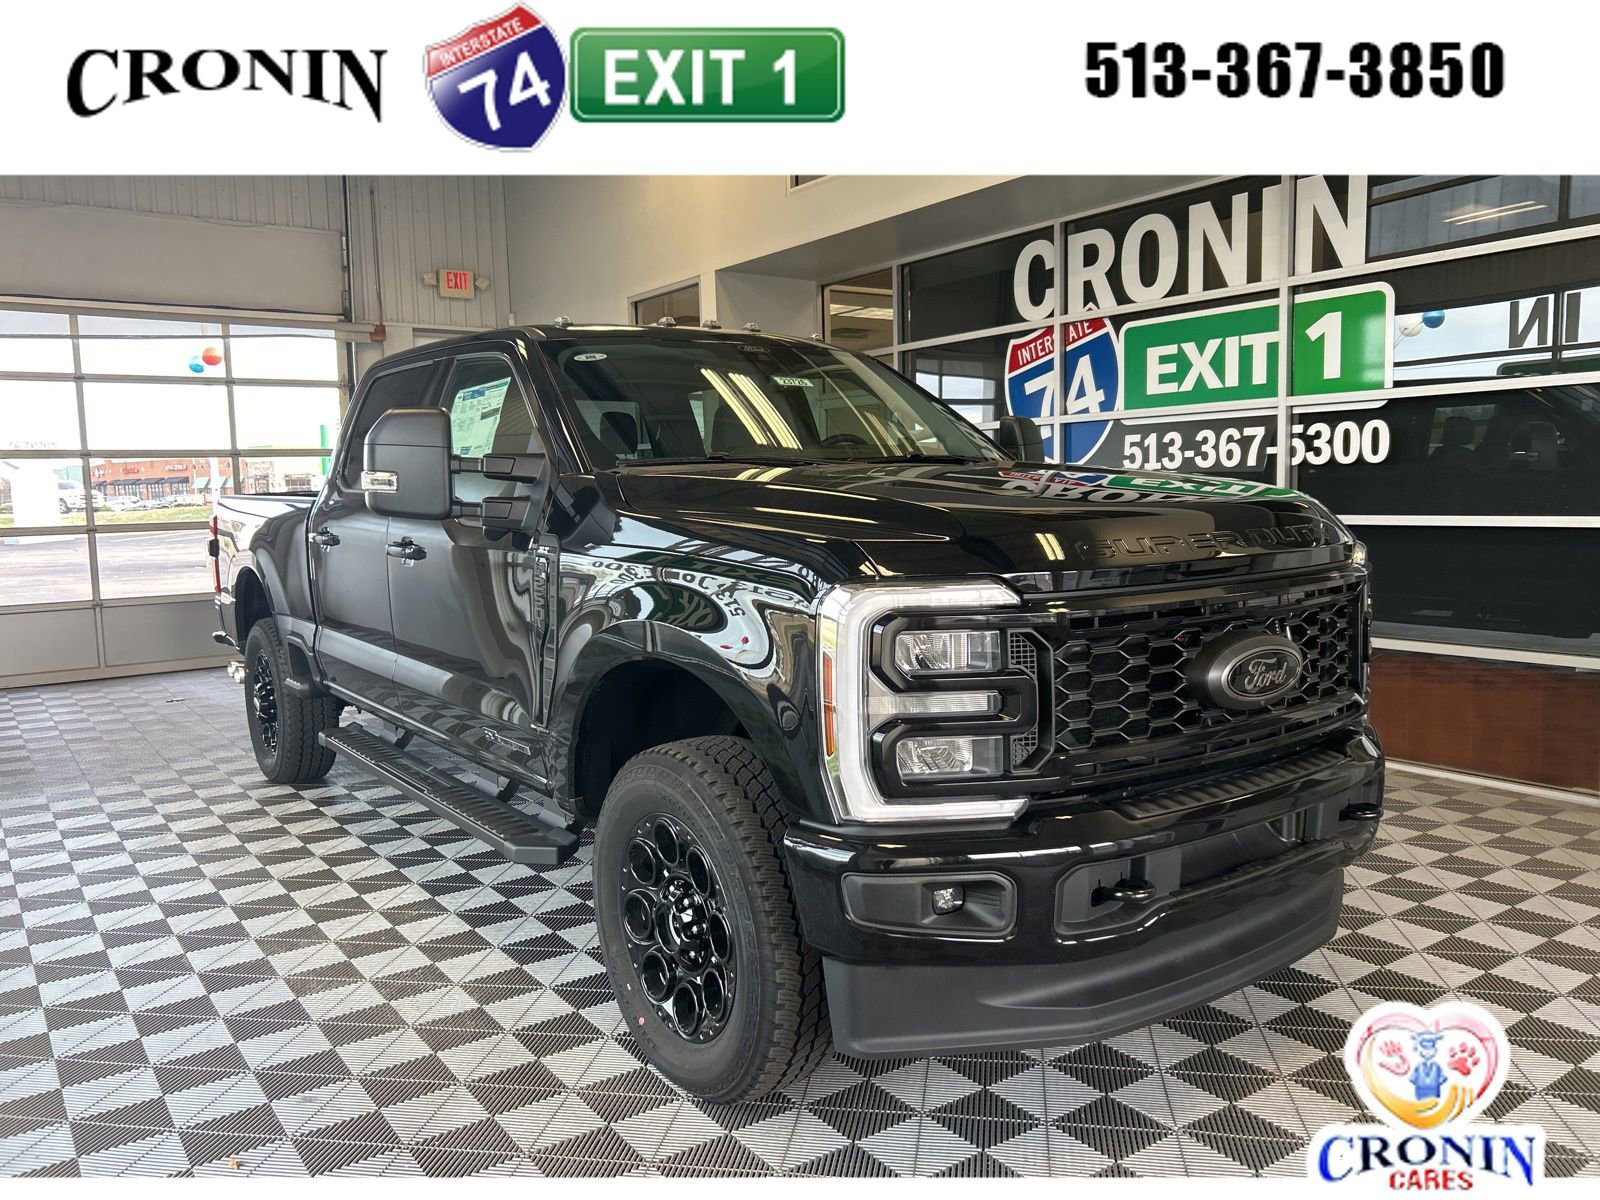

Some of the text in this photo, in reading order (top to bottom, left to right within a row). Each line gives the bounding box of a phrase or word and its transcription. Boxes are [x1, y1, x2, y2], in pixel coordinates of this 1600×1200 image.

[1013, 175, 1367, 322] CRONIN
[446, 271, 468, 290] EXIT
[1146, 311, 1342, 396] EXIT 1
[1024, 354, 1105, 440] 74
[1122, 419, 1390, 471] 513-367-5300
[1097, 530, 1248, 559] SUPER
[1244, 657, 1287, 691] Ford
